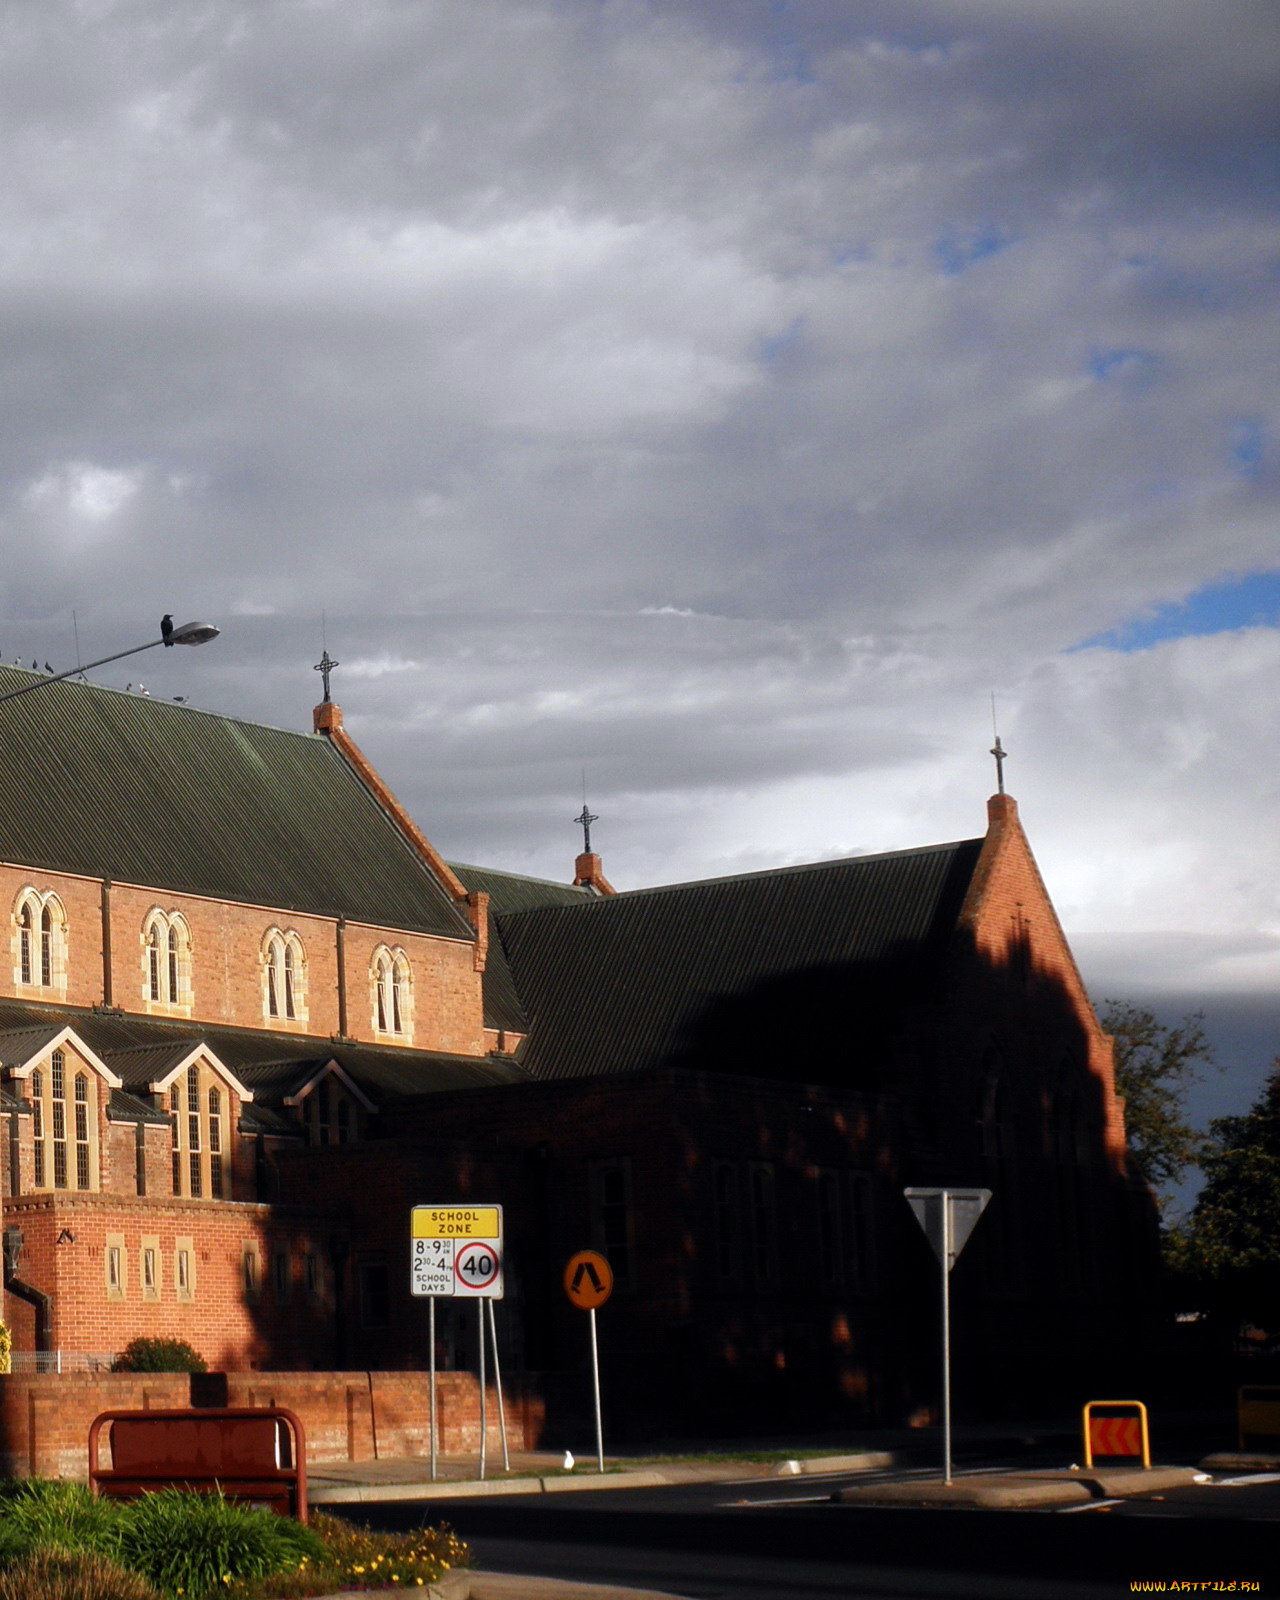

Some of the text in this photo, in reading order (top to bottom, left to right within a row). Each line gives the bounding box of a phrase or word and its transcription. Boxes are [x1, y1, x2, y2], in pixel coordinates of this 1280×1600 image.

[431, 1212, 479, 1221] SCHOOL
[438, 1224, 472, 1233] ZONE
[462, 1255, 492, 1276] 40
[416, 1274, 450, 1282] SCHOOL
[421, 1283, 445, 1292] DAYS
